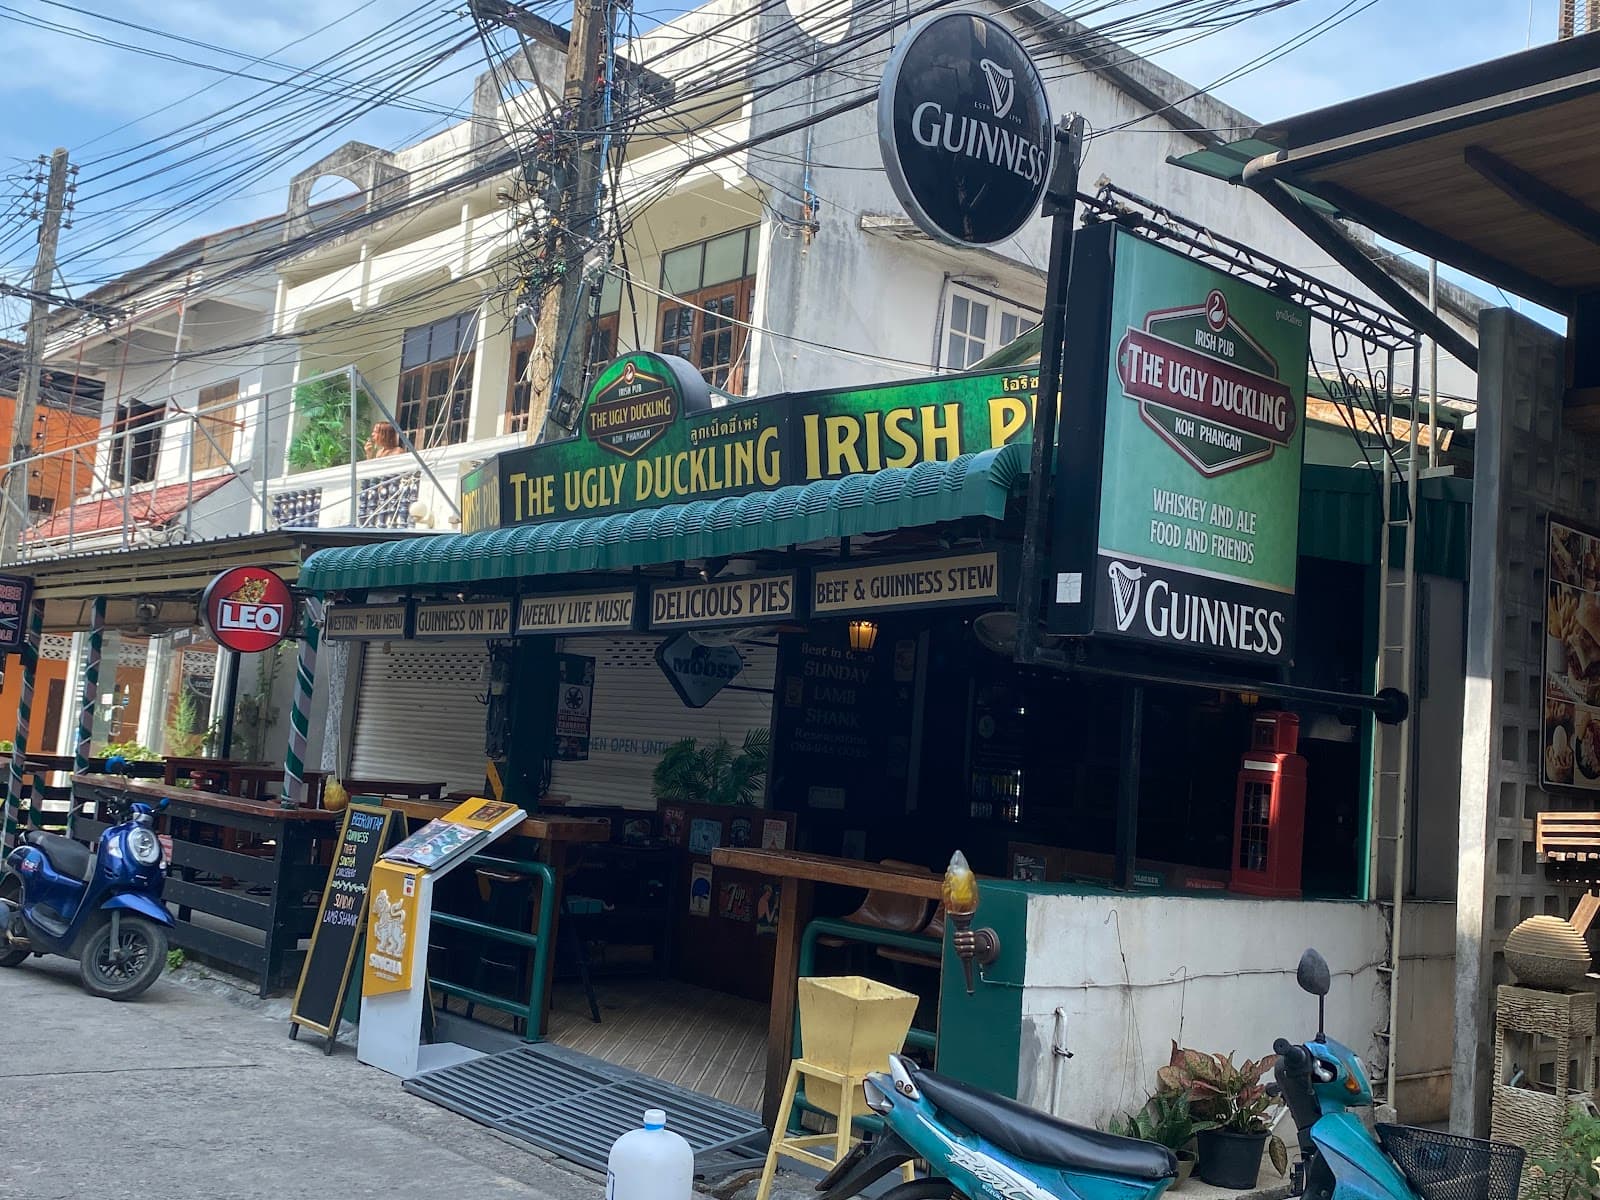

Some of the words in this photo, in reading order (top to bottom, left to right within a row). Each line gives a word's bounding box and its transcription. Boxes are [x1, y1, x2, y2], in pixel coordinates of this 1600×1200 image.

[912, 101, 1045, 184] GUINNESS
[1195, 329, 1216, 352] IRISH
[1218, 338, 1234, 357] PUB
[618, 387, 631, 397] IRISH
[1128, 343, 1164, 388] THE
[1168, 360, 1208, 402] UGLY
[1211, 376, 1286, 432] DUCKLING
[591, 412, 608, 430] THE
[609, 407, 628, 425] UGLY
[631, 396, 670, 421] DUCKLING
[803, 402, 960, 480] IRISH
[1175, 416, 1195, 438] KOH
[1199, 425, 1242, 453] PHANGAN
[510, 472, 555, 521] THE
[564, 463, 628, 512] UGLY
[635, 426, 781, 503] DUCKLING
[1153, 488, 1207, 522] WHISKEY
[1210, 503, 1233, 530] AND
[1236, 510, 1257, 535] ALE
[1150, 520, 1181, 547] FOOD
[1184, 529, 1208, 554] AND
[1211, 534, 1254, 565] FRIENDS
[817, 580, 848, 604] BEEF
[853, 579, 865, 600] &
[870, 570, 942, 599] GUINNESS
[947, 565, 993, 592] STEW
[522, 601, 566, 626] WEEKLY
[567, 600, 591, 623] LIVE
[594, 599, 632, 623] MUSIC
[654, 585, 743, 621] DELICIOUS
[749, 580, 790, 614] PIES
[222, 604, 280, 631] LEO
[328, 615, 358, 631] WESTERN
[366, 614, 382, 630] THAI
[382, 613, 403, 630] MENU
[418, 610, 465, 632] GUINNESS
[468, 609, 483, 630] ON
[487, 608, 508, 630] TAP
[1145, 579, 1283, 655] GUINNESS
[803, 660, 871, 684] SUNDAY
[815, 685, 857, 704] LAMB
[804, 708, 864, 729] SHANK
[611, 738, 637, 753] OPEN
[323, 909, 338, 925] LAMB
